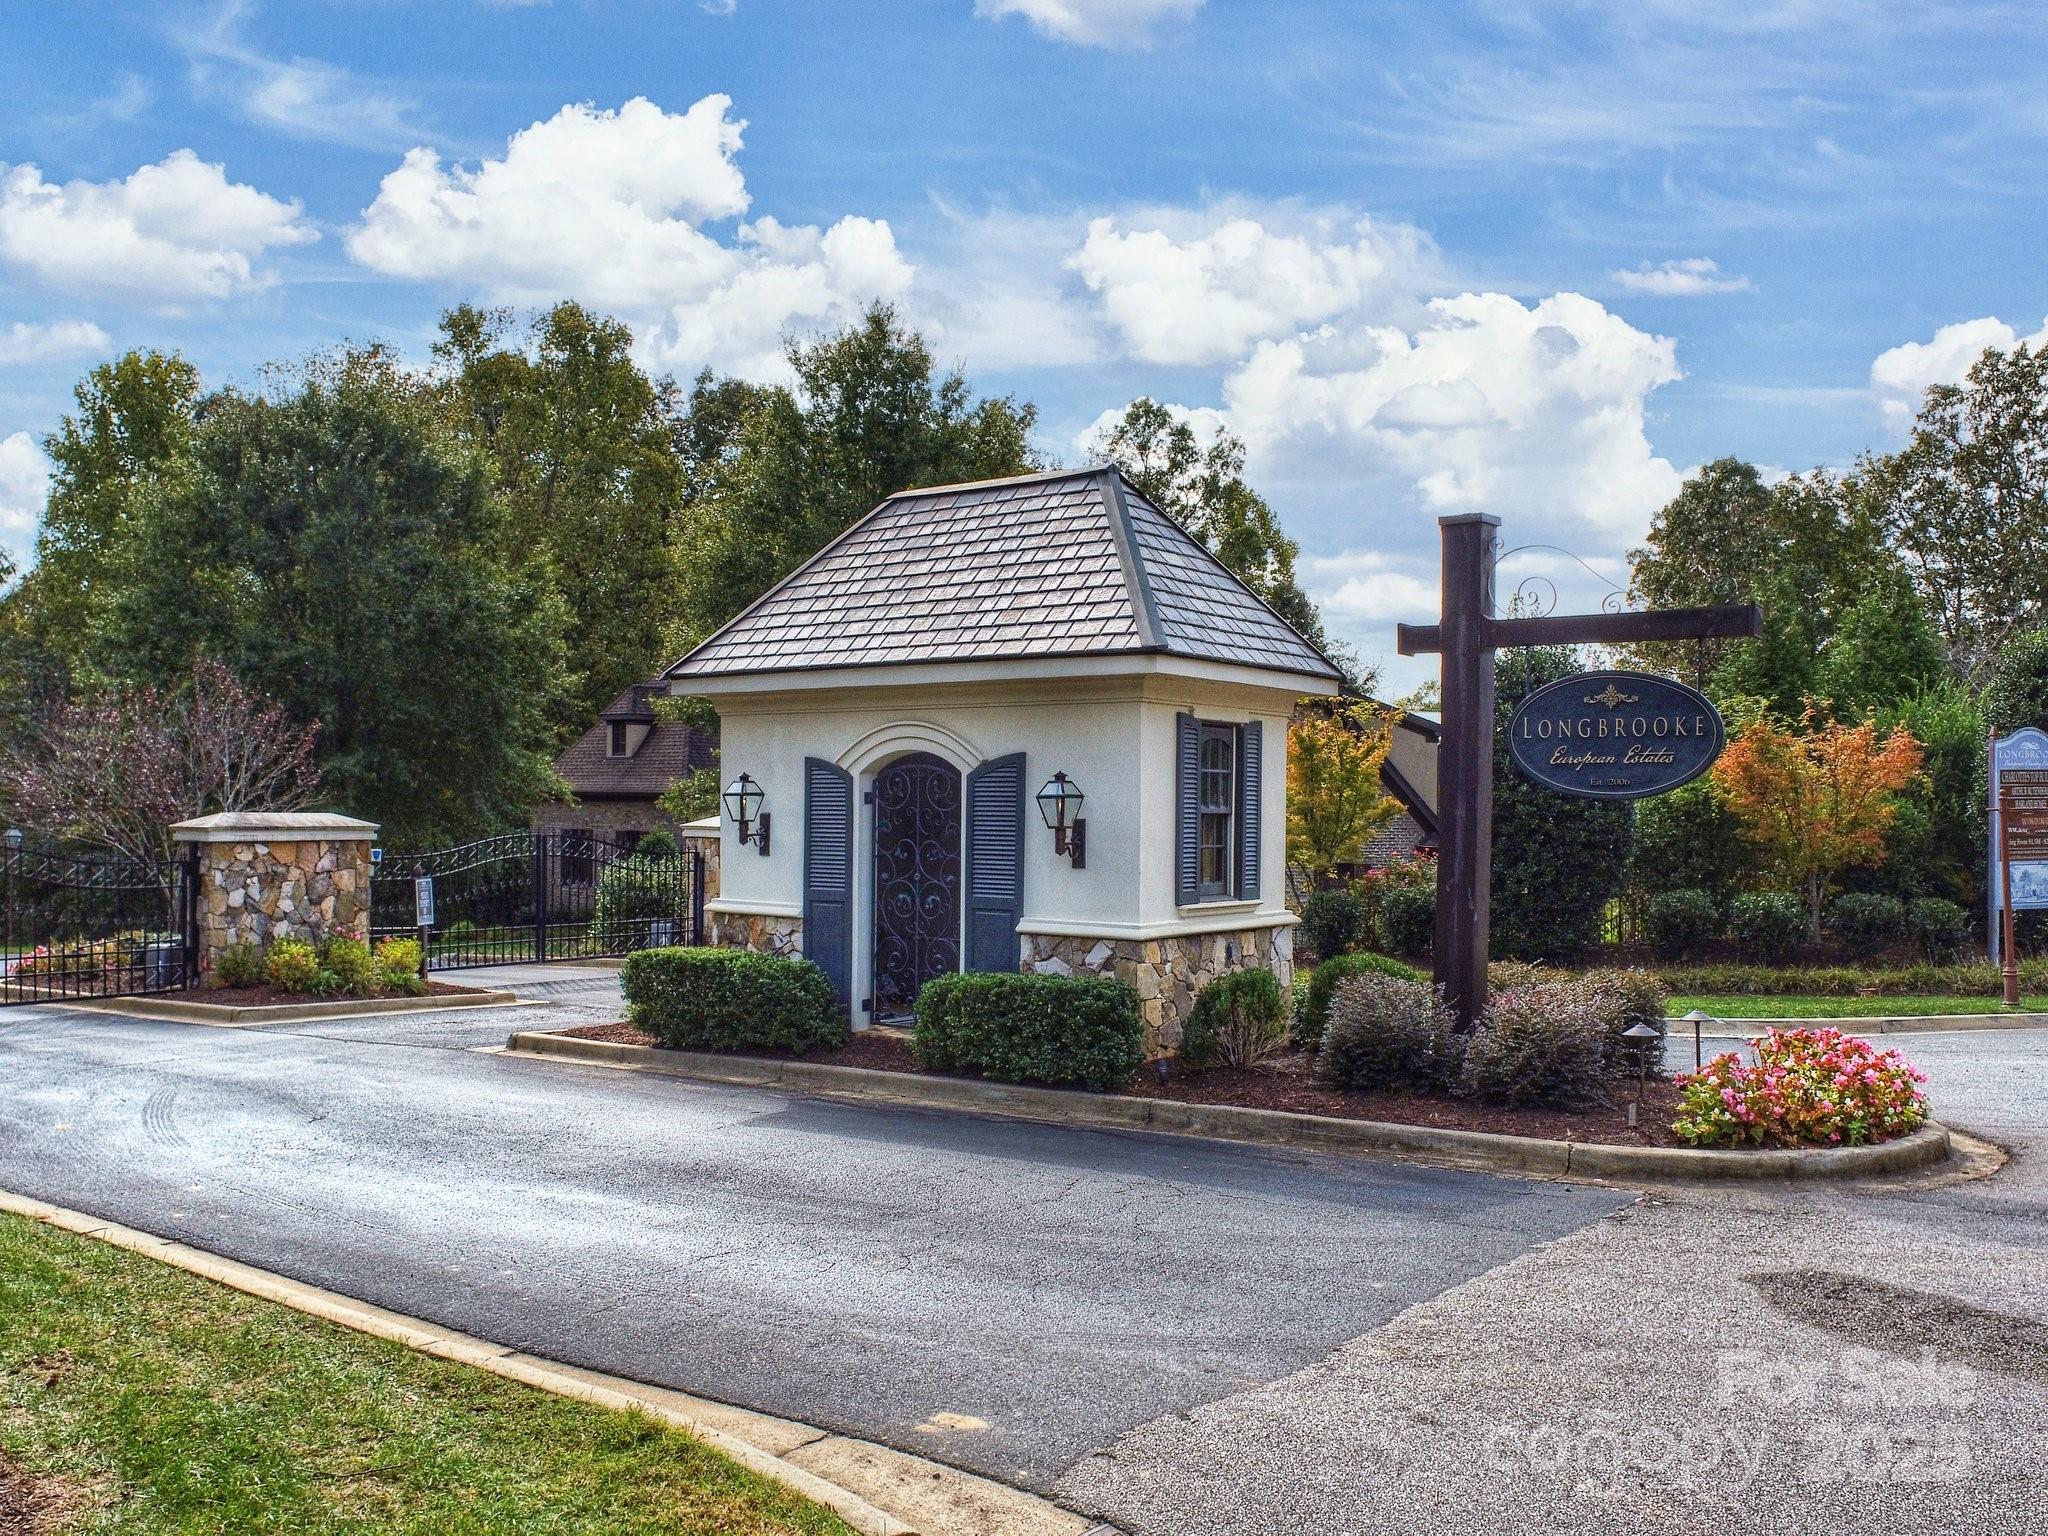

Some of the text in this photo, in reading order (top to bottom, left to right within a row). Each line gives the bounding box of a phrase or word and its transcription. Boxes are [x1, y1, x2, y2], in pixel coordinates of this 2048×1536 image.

[1523, 716, 1704, 739] LONGBROOKE
[1549, 744, 1675, 771] European Estates
[1608, 778, 1631, 786] 2006
